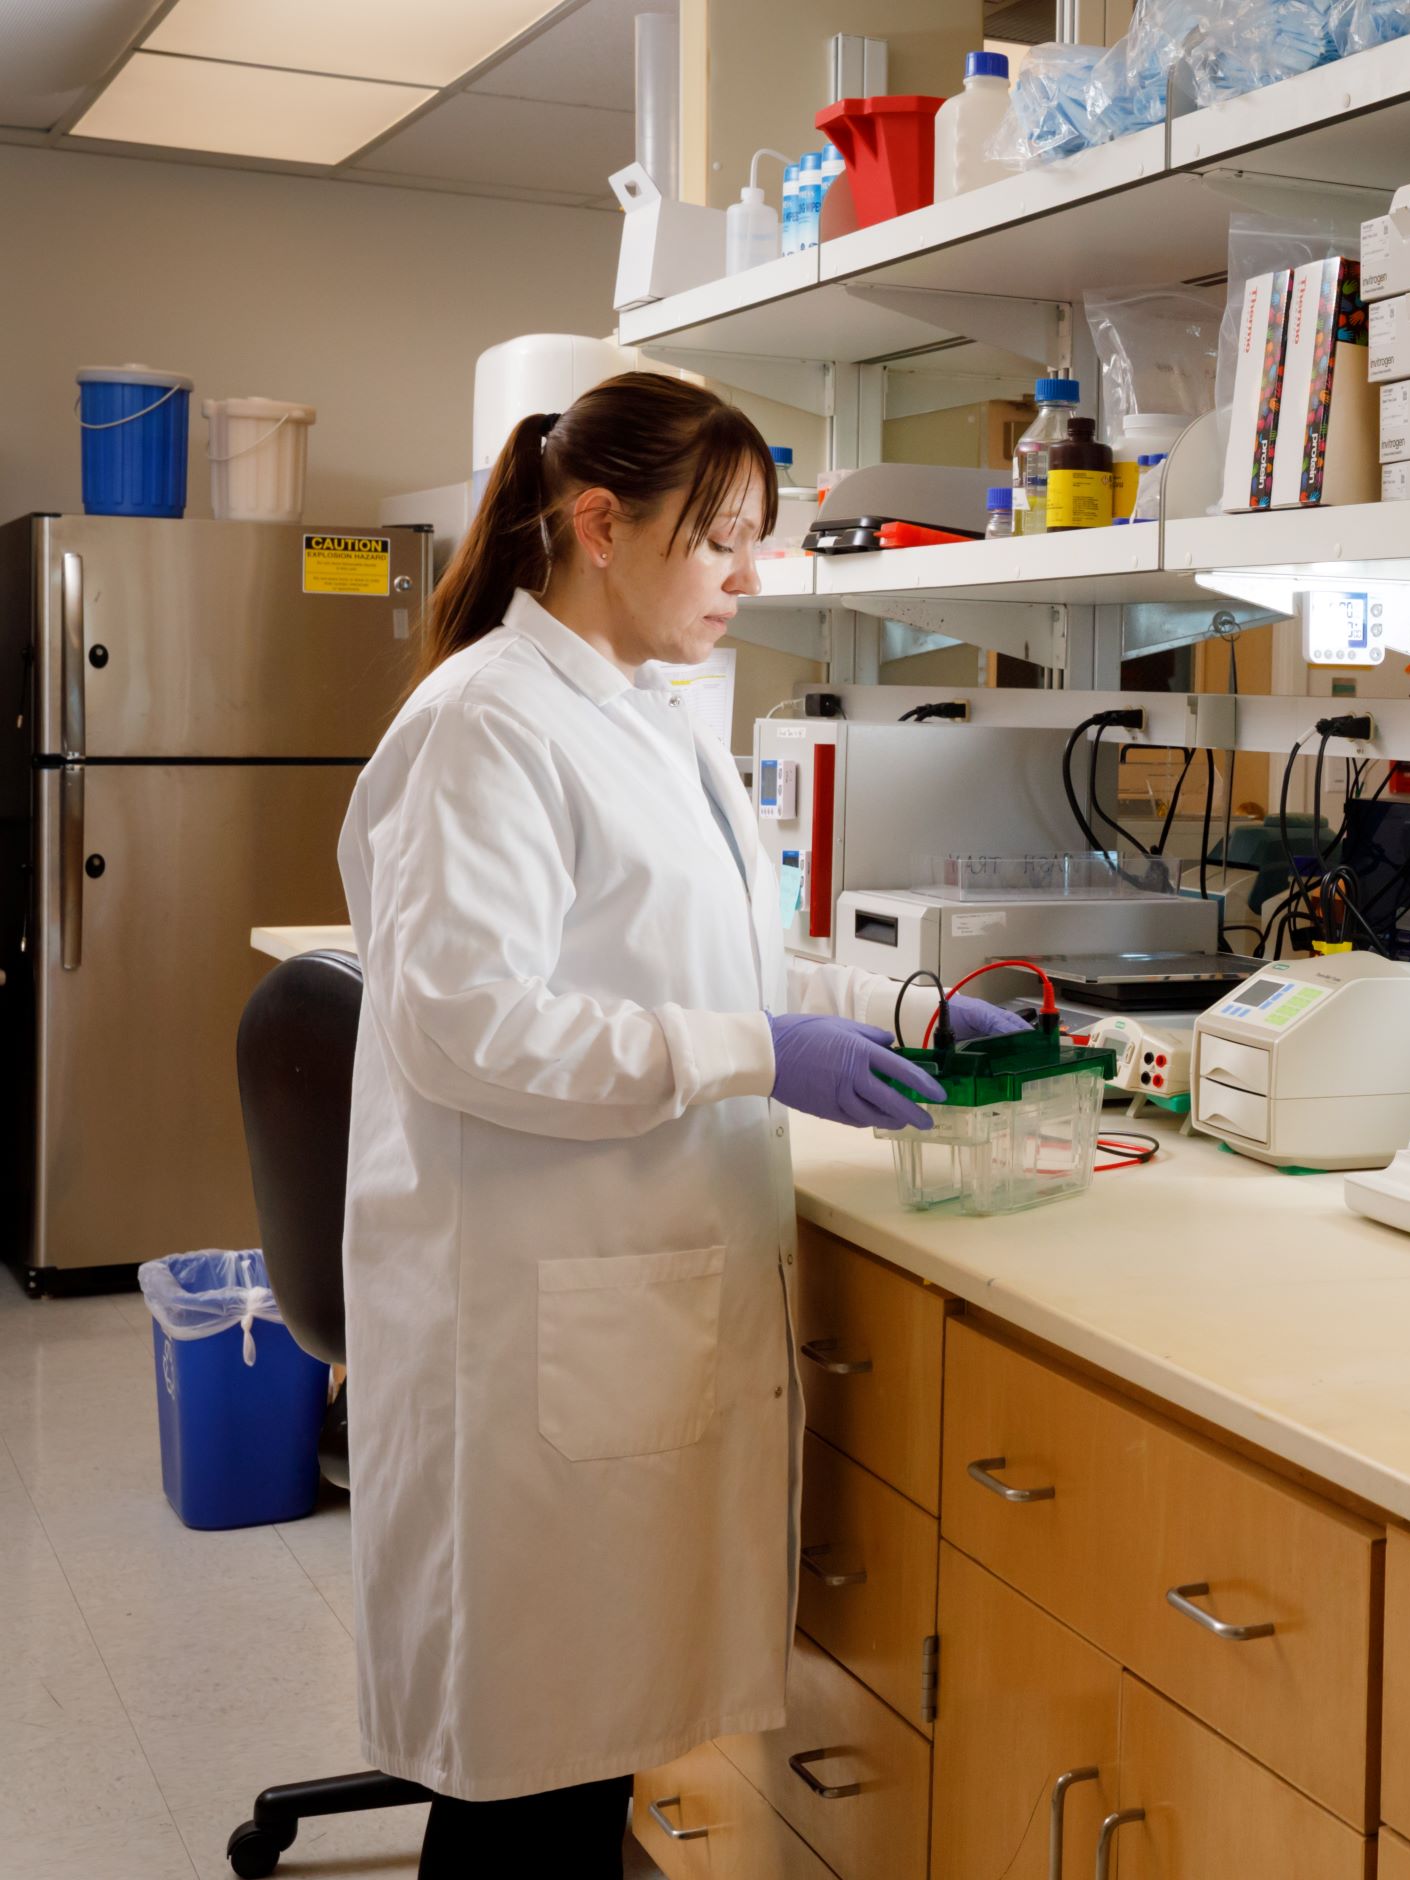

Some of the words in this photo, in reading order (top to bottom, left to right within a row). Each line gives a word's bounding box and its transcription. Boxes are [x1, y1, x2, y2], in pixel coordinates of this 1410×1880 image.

[1362, 272, 1388, 287] invitrogen
[1295, 275, 1308, 345] Thermo
[1244, 285, 1259, 354] Thermo
[1370, 354, 1395, 369] invitrogen
[1381, 437, 1406, 451] invitrogen
[1258, 439, 1268, 489] protein
[1309, 433, 1319, 484] protein
[311, 536, 382, 552] CAUTION
[307, 551, 352, 560] EXPLOSION
[354, 553, 387, 561] HAZARD
